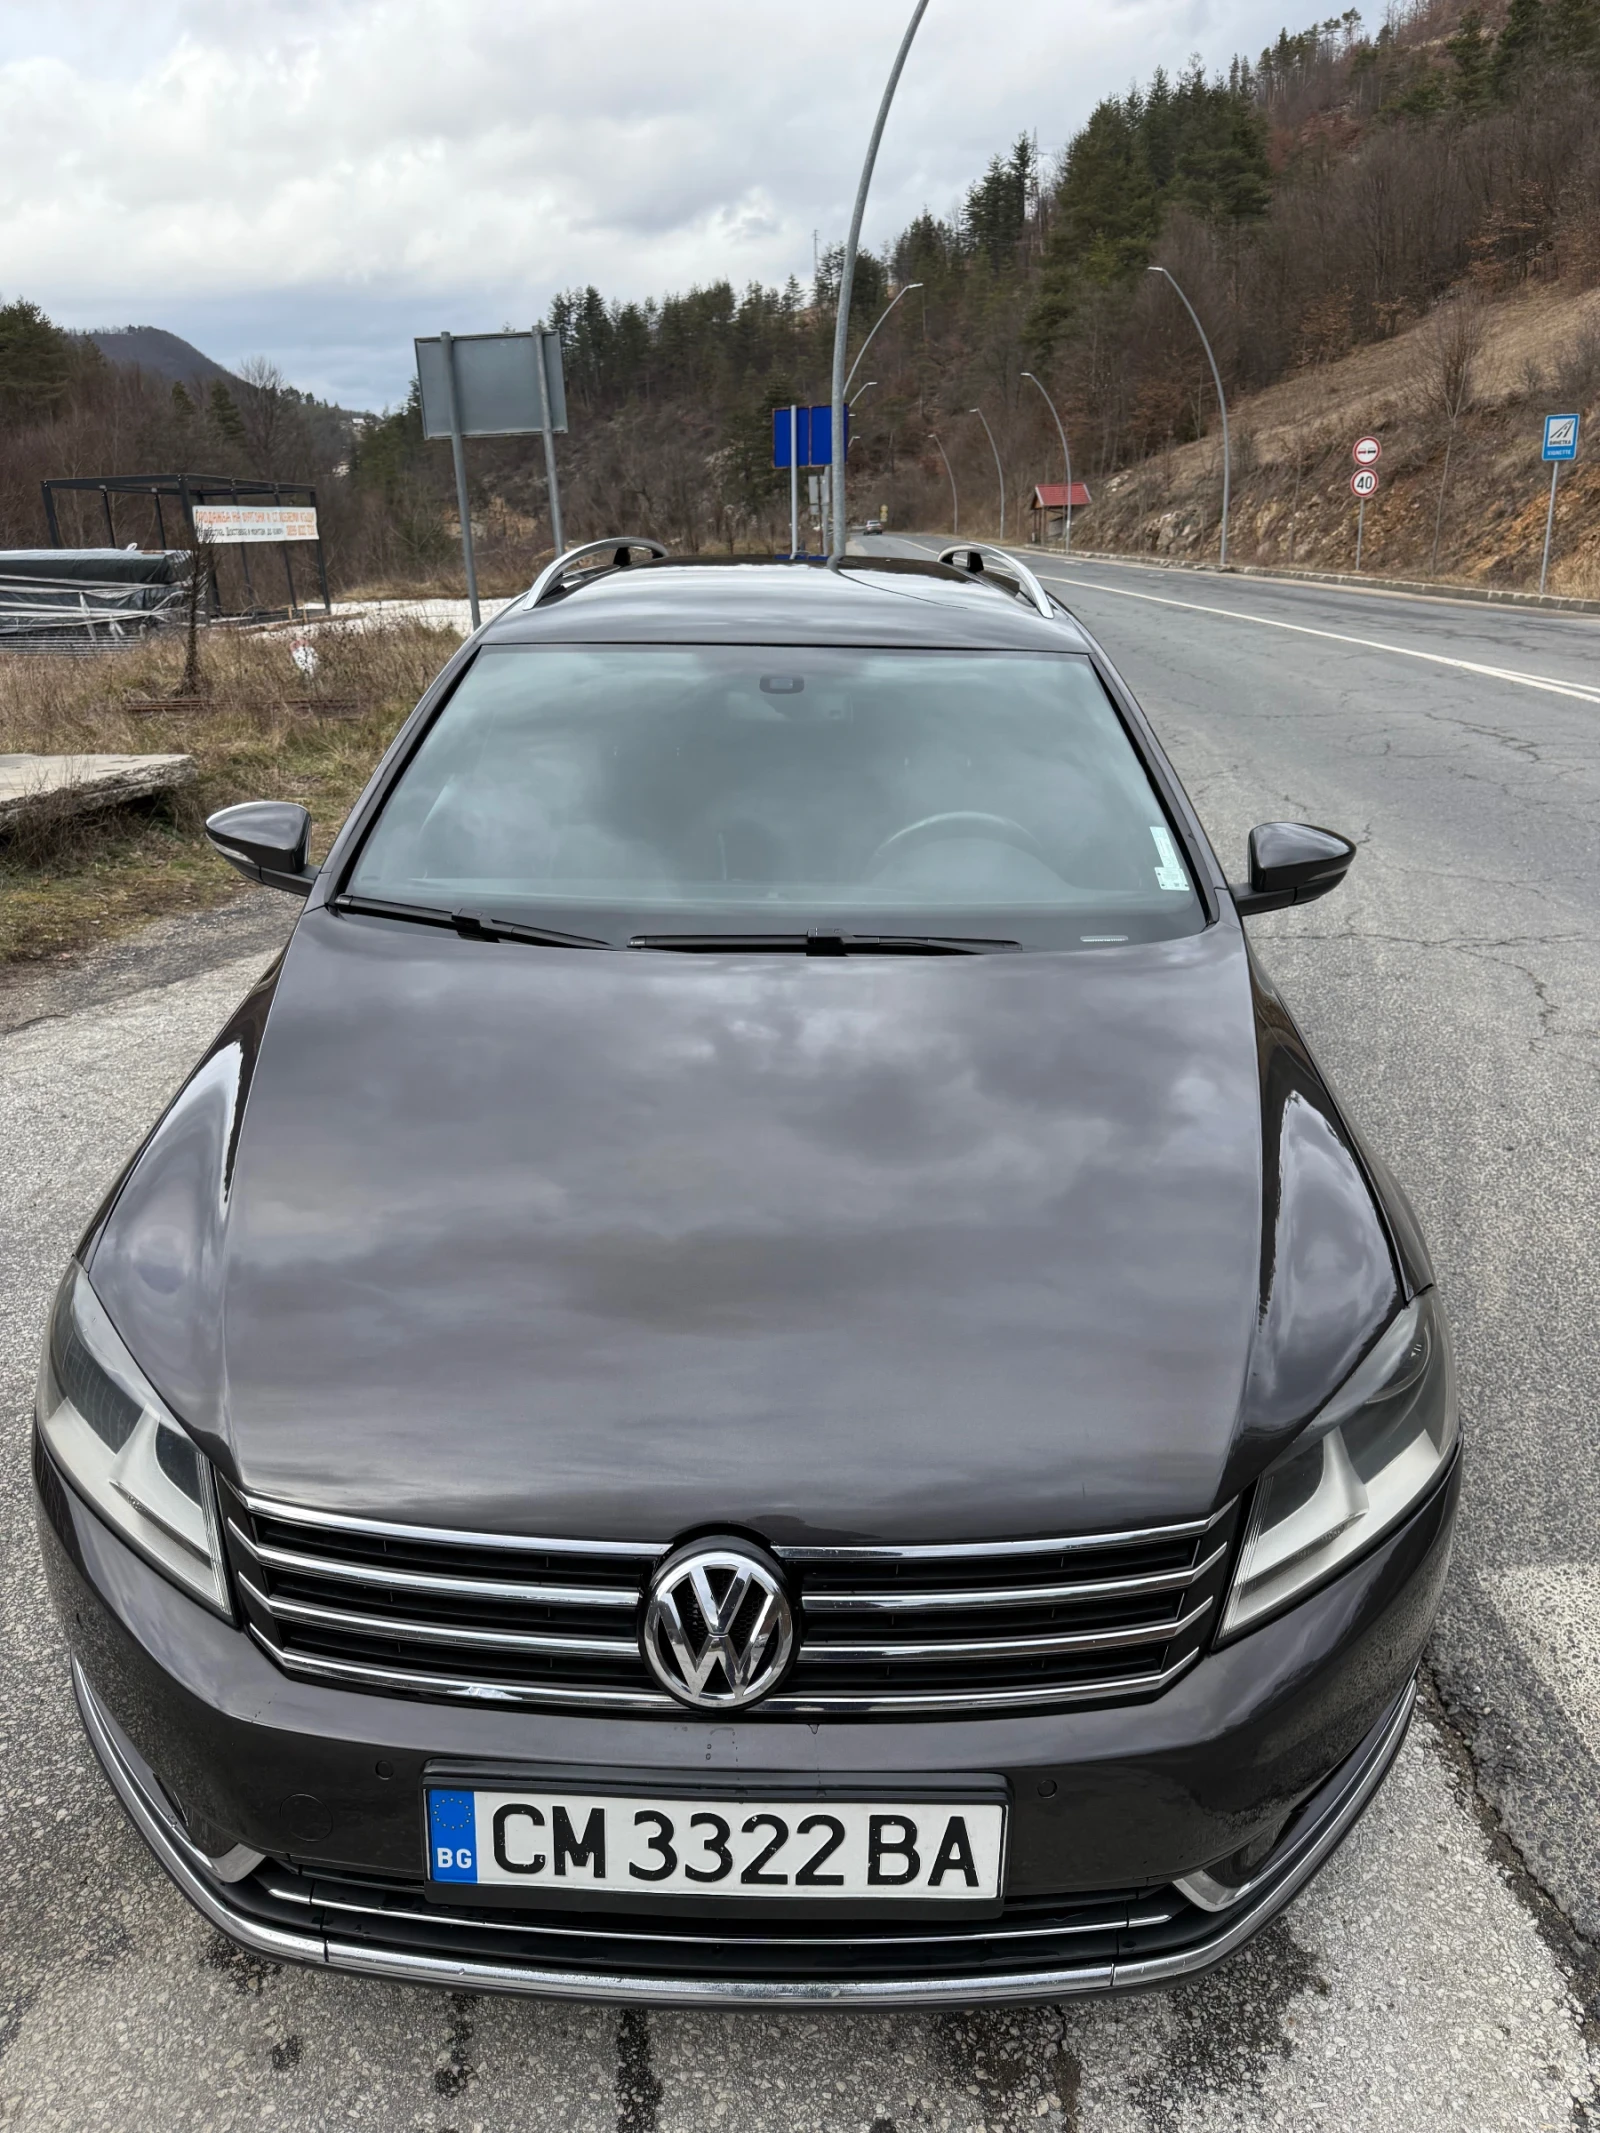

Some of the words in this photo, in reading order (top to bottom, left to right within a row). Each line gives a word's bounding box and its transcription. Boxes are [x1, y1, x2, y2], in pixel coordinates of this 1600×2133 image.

[1356, 476, 1373, 489] 40
[493, 1803, 606, 1878] CM
[629, 1810, 845, 1886] 3322
[867, 1814, 979, 1887] BA
[437, 1847, 472, 1869] BG
